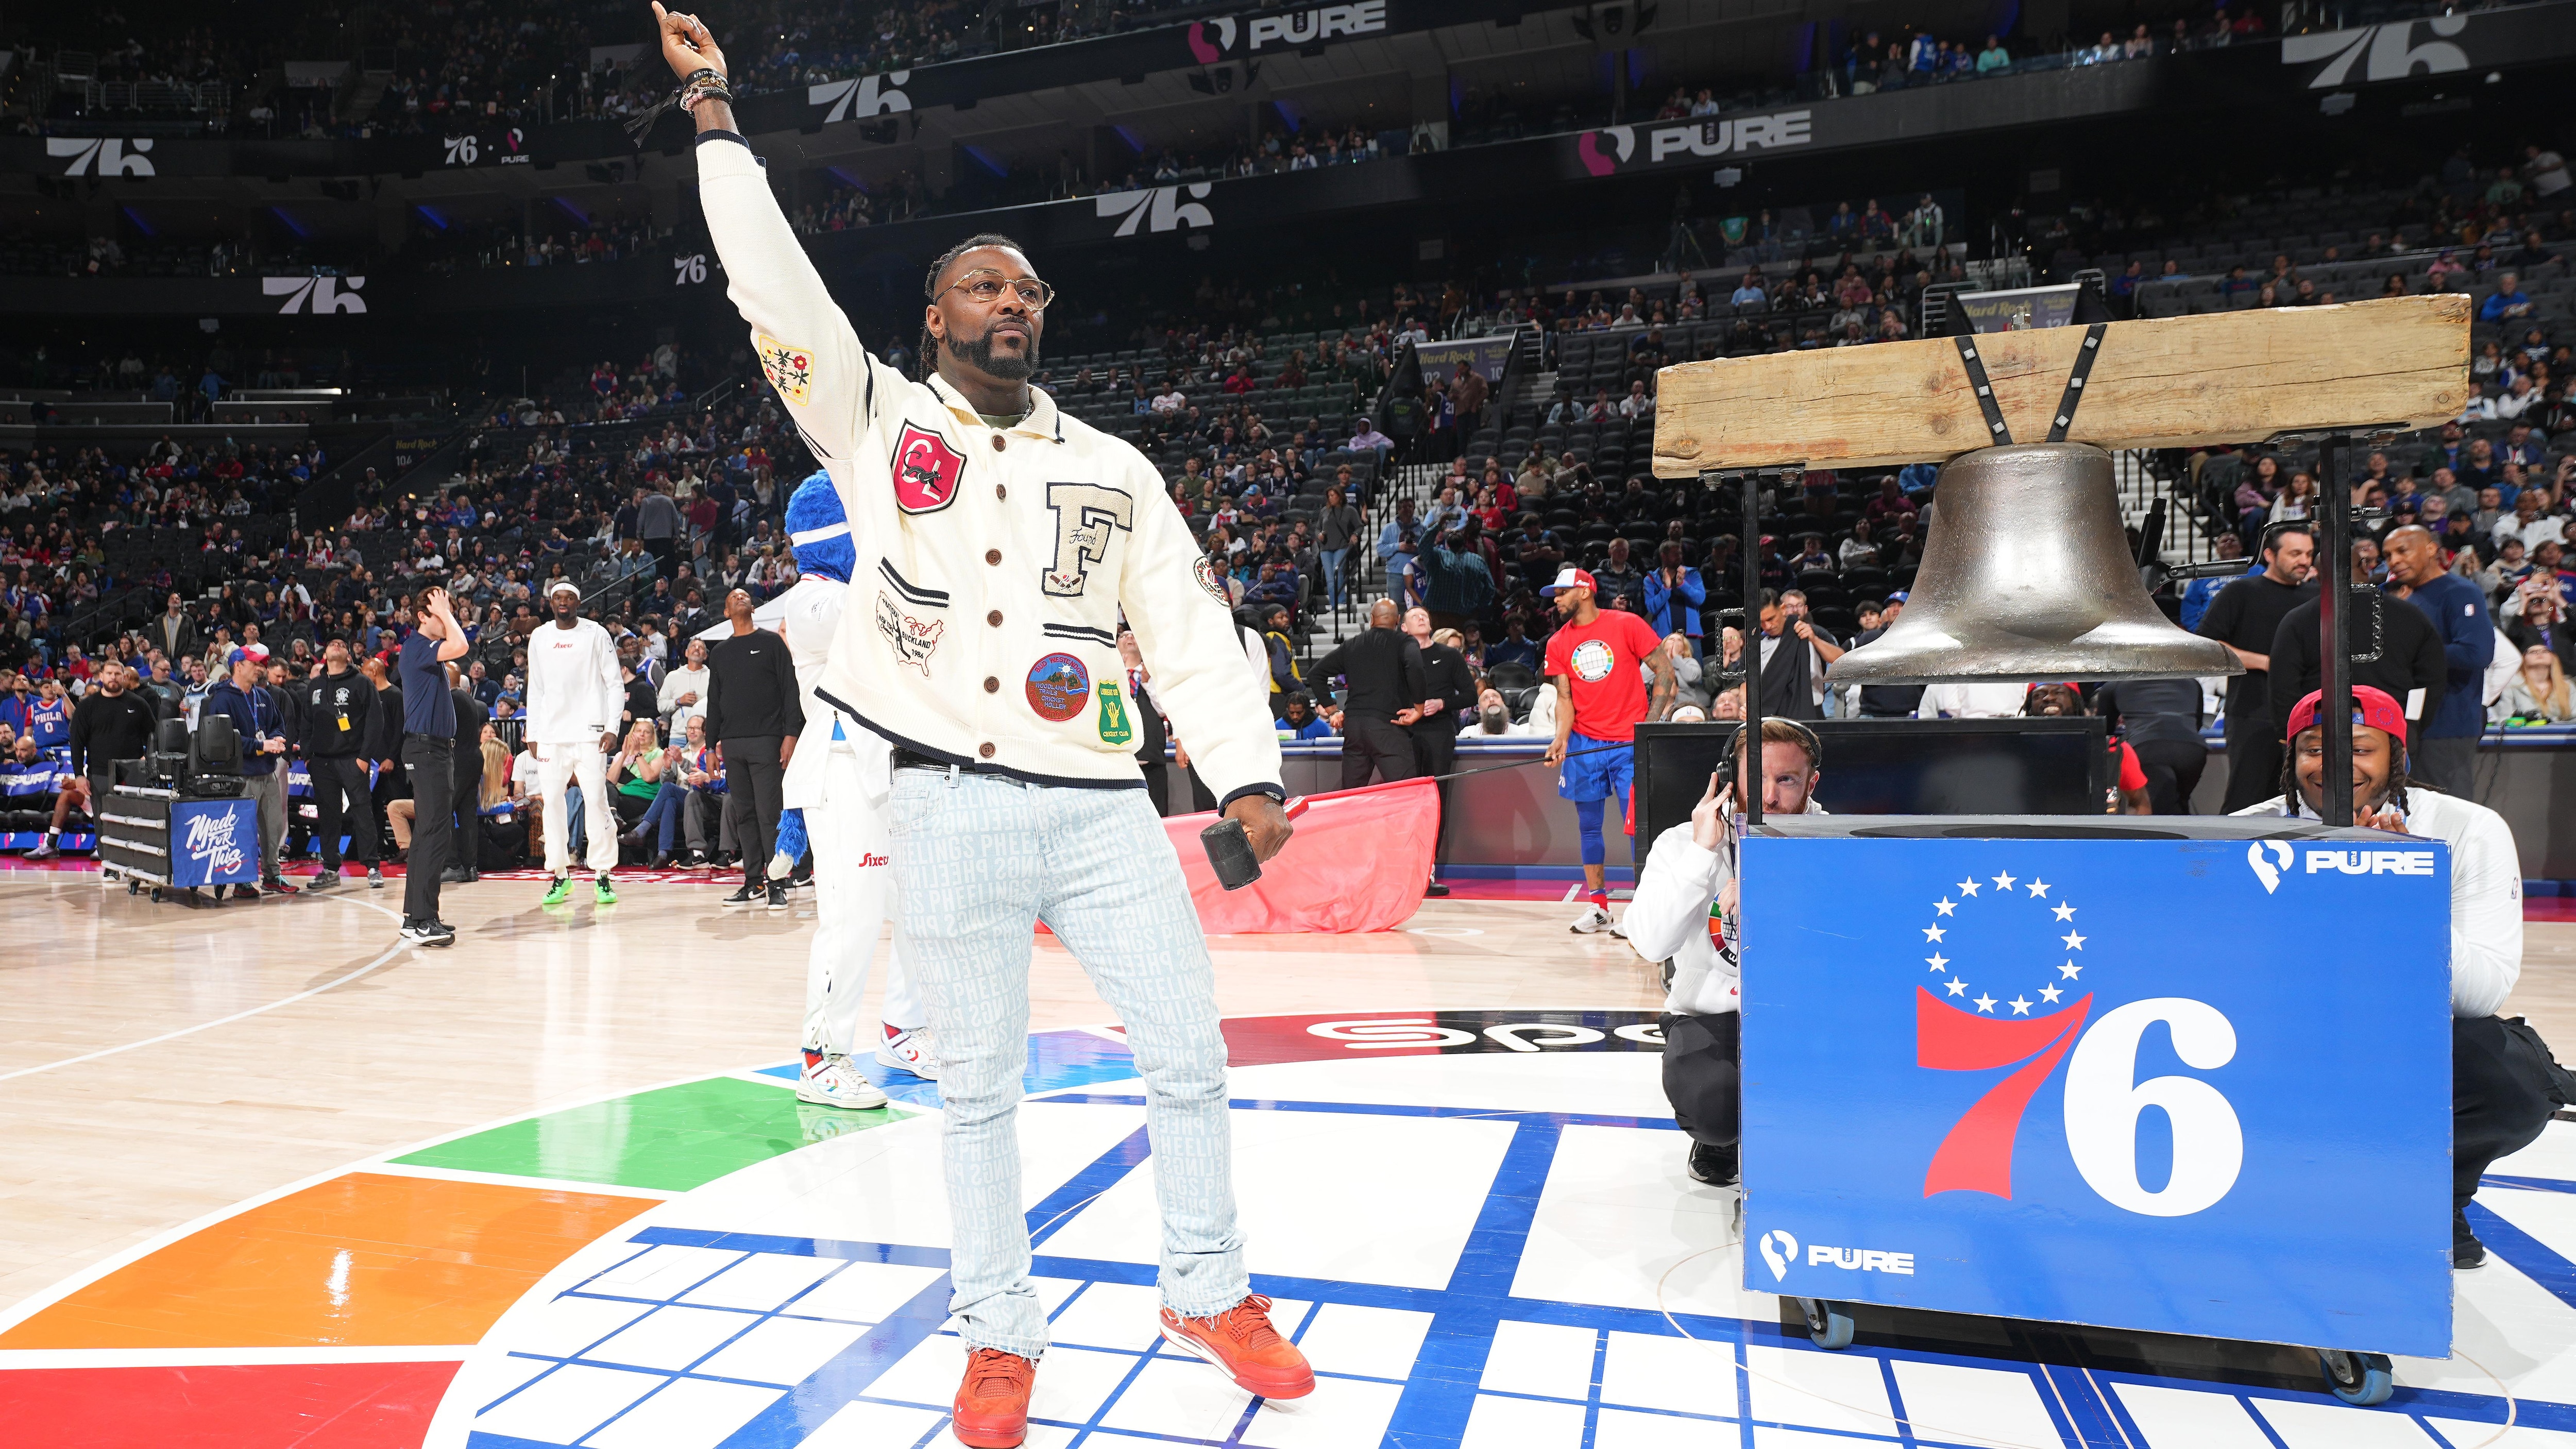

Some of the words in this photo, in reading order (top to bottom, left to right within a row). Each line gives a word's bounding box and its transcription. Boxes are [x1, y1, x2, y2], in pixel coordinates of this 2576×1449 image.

[1249, 1, 1386, 49] PURE
[2282, 15, 2471, 89] 76
[808, 70, 912, 124] 76
[444, 135, 478, 165] 76
[1651, 110, 1811, 162] PURE
[46, 137, 156, 177] 76
[501, 155, 530, 164] PURE
[1096, 182, 1214, 237] 76
[674, 254, 707, 286] 76
[262, 276, 367, 314] 76
[1420, 351, 1447, 366] Hard
[1448, 349, 1476, 364] Rock
[396, 439, 416, 450] Hard
[1041, 481, 1132, 596] F
[1069, 527, 1098, 545] Found
[902, 631, 931, 649] BUCKLAND
[911, 649, 924, 659] 1986
[1035, 660, 1047, 673] BUD
[1049, 657, 1085, 679] WESTENDORF
[1036, 683, 1066, 692] WOODLAND
[35, 711, 63, 725] PHILA
[1044, 702, 1066, 710] HOLLER
[44, 721, 54, 734] 0
[184, 803, 240, 849] Made
[191, 844, 245, 884] This
[2306, 850, 2434, 875] PURE
[1917, 984, 2243, 1217] 76
[1808, 1245, 1914, 1275] PURE
